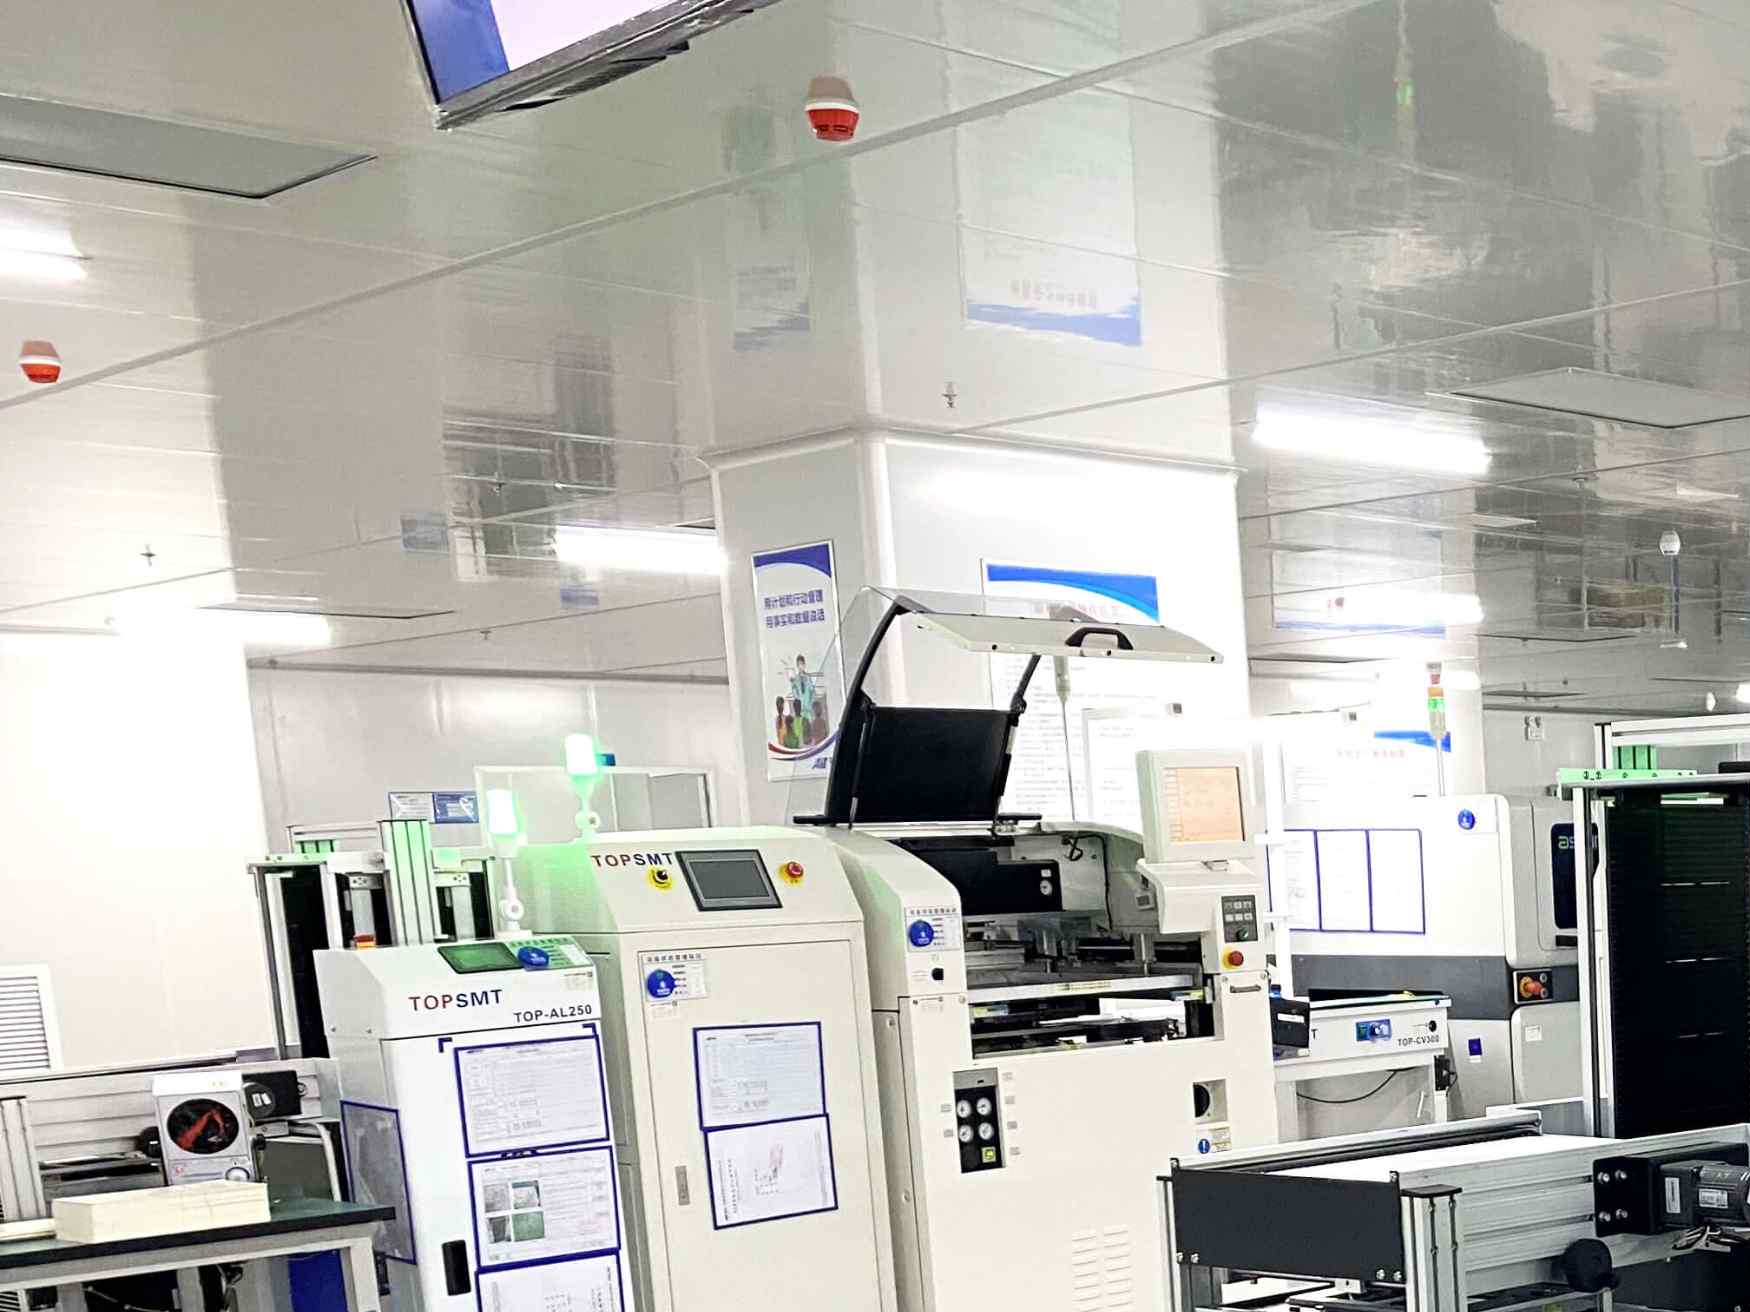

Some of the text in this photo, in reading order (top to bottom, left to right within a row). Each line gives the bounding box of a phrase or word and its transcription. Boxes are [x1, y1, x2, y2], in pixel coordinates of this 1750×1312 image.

[592, 852, 674, 868] TOPSMT
[407, 989, 503, 1012] TOPSMT
[513, 1004, 593, 1024] TOP-AL250
